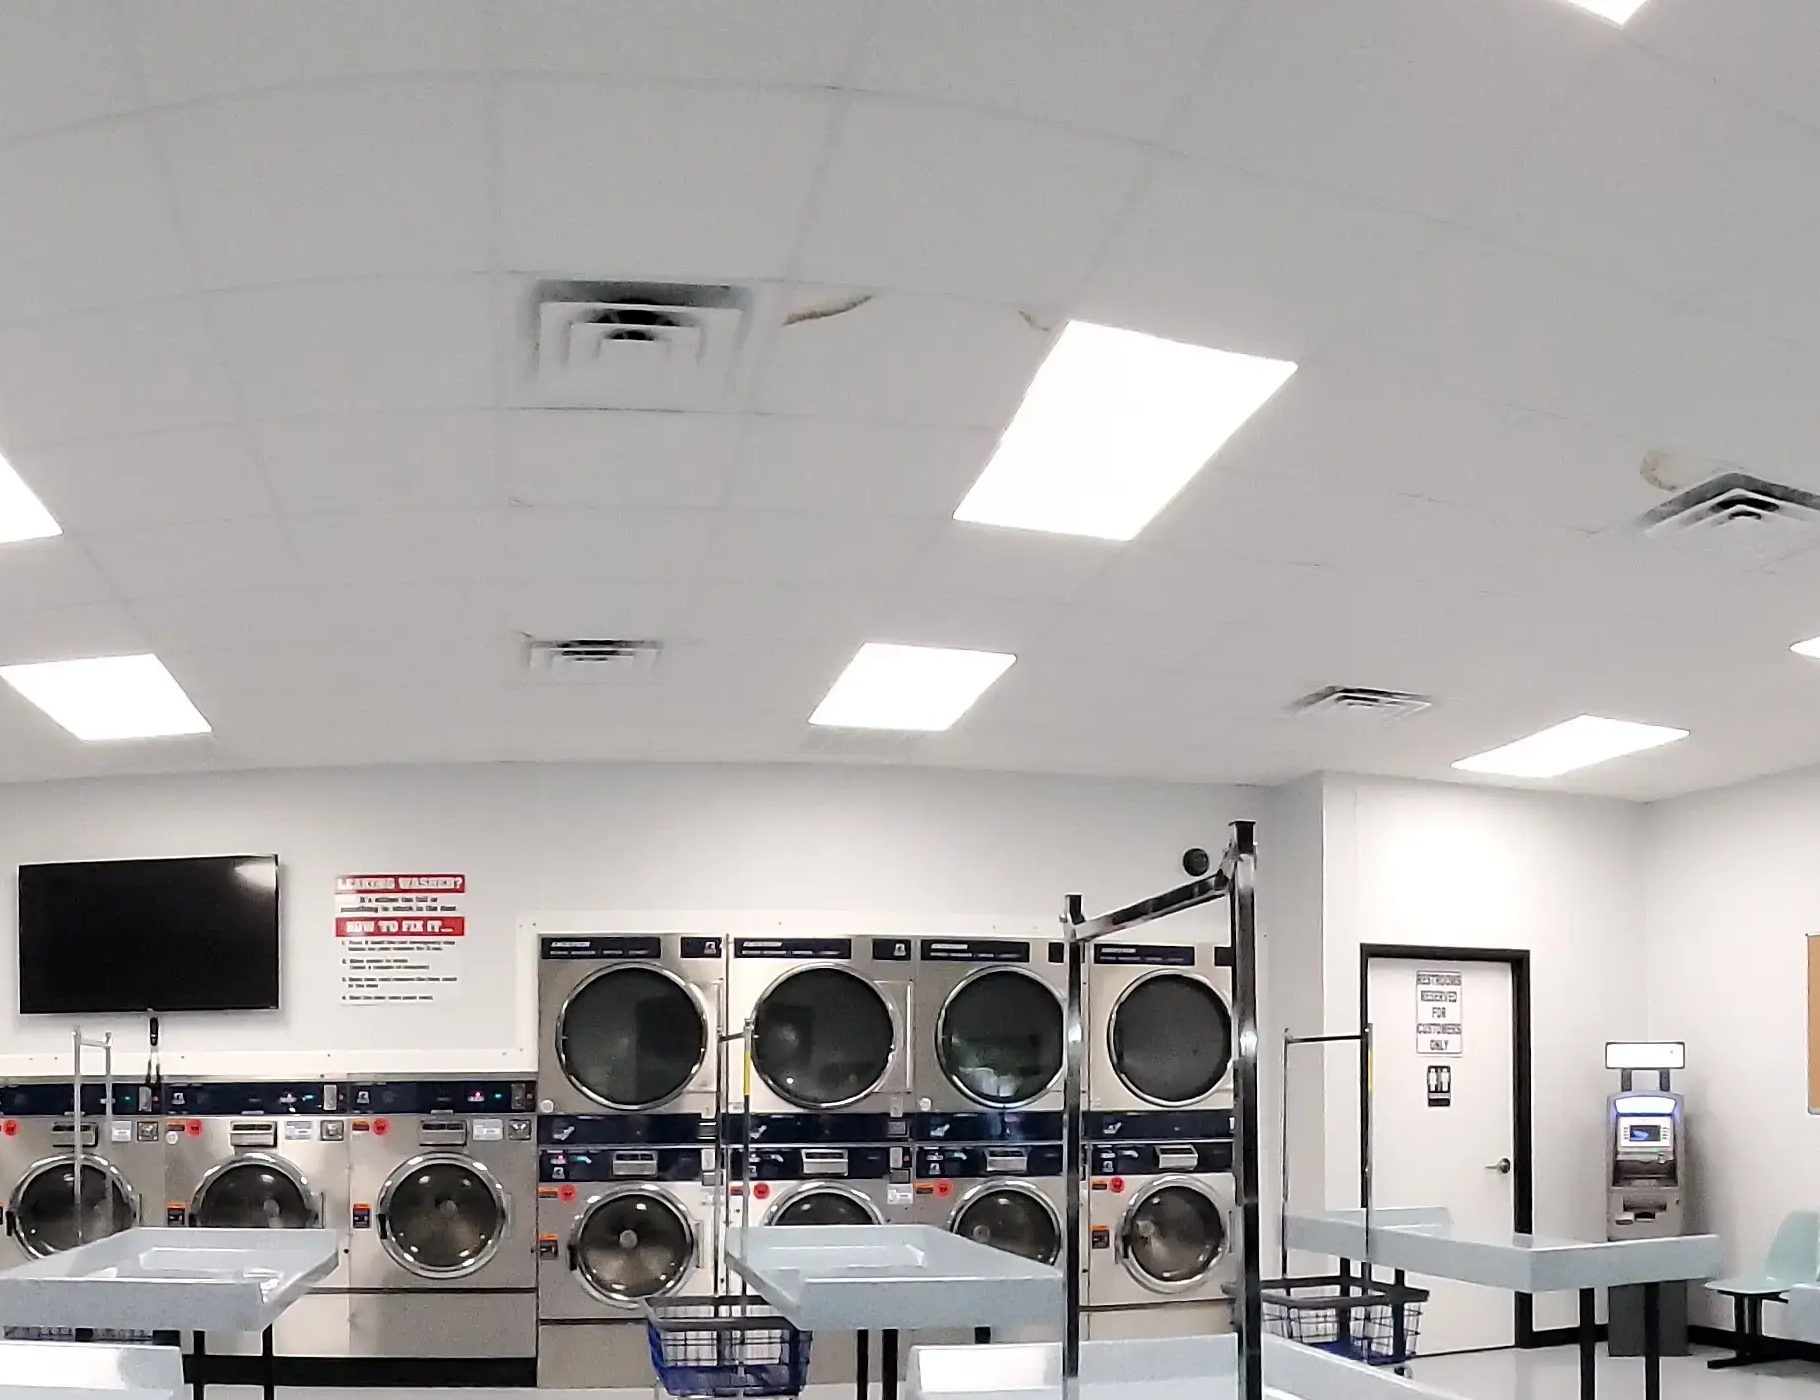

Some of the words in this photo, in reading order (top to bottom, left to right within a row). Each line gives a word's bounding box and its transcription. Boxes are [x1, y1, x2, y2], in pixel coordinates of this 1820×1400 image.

[345, 920, 376, 933] HOW
[377, 920, 399, 933] TO
[401, 920, 425, 933] FIX
[1432, 1006, 1447, 1018] FOR
[1429, 1039, 1449, 1050] ONLY
